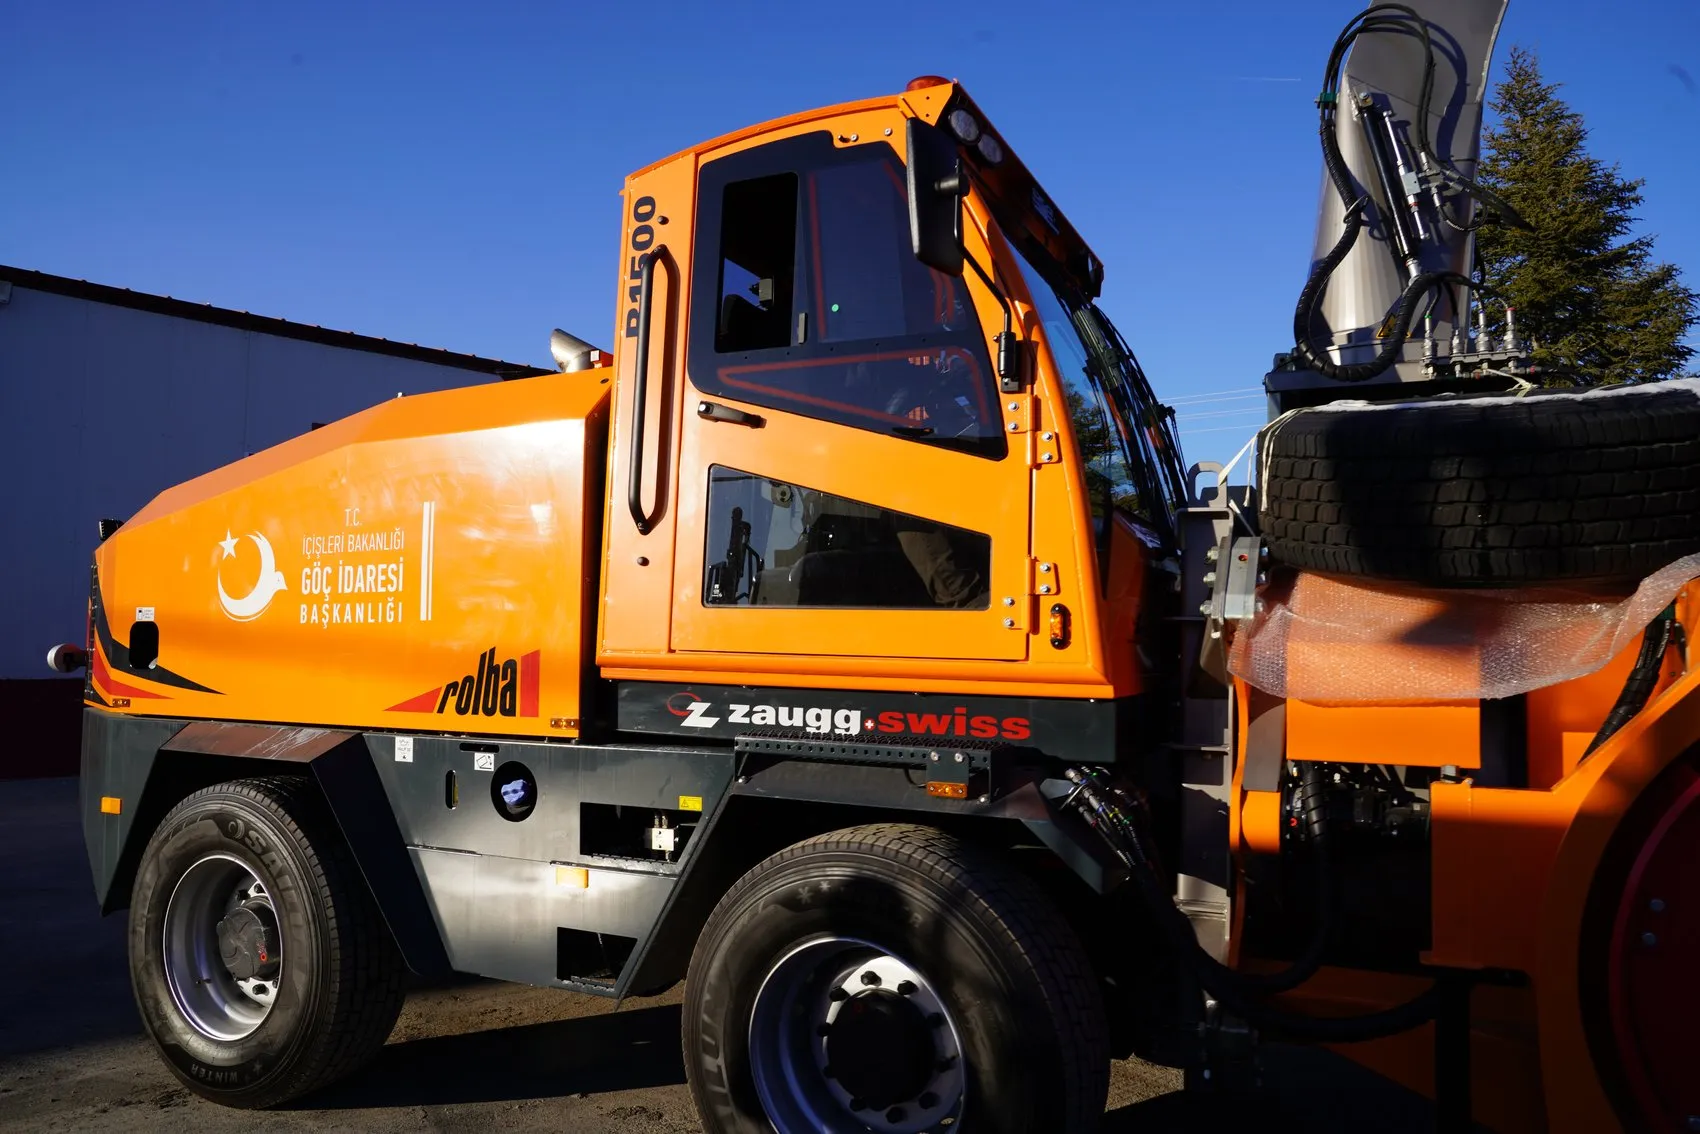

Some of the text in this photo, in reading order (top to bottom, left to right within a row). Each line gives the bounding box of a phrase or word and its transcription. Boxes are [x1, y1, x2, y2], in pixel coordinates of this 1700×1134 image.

[345, 508, 362, 527] T.C.
[302, 527, 404, 559] İÇİŞLERİ BAKANLIĞI
[301, 556, 404, 601] GÖÇ İDARESİ
[300, 597, 403, 629] BAŞKANLIĞI
[436, 646, 518, 717] rolba
[728, 704, 862, 735] zaugg
[878, 707, 1031, 740] swiss
[190, 1063, 239, 1084] WINTER
